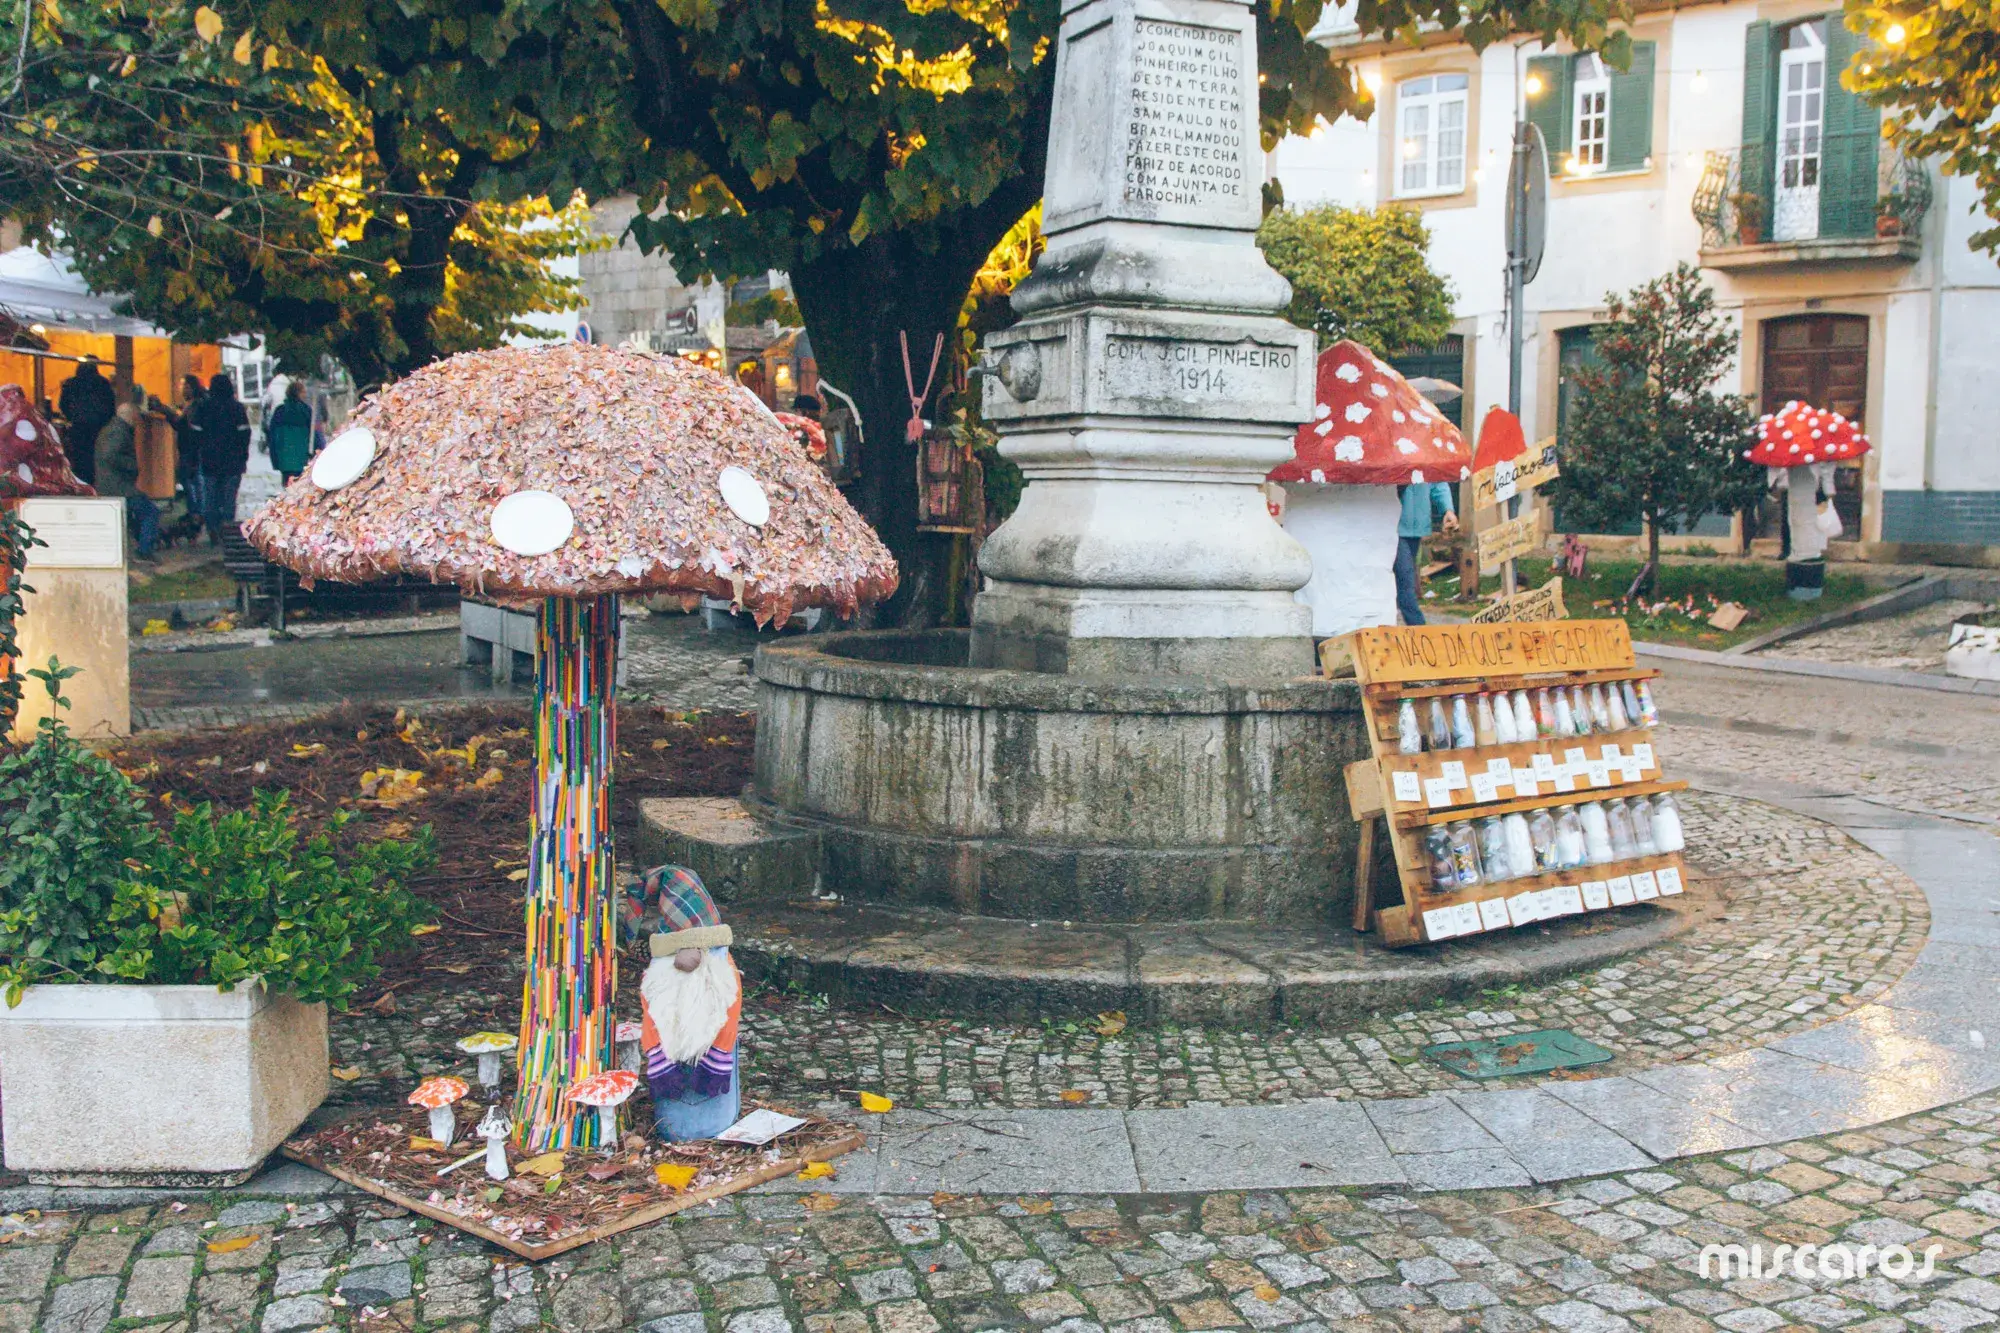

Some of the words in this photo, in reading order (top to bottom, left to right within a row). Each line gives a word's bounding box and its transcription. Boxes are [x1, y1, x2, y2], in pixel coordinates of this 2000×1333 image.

[1146, 24, 1235, 46] COMENDADOR
[1138, 41, 1203, 58] JOAQUIM
[1201, 63, 1238, 79] FILHO
[1132, 71, 1182, 89] DESTA
[1188, 79, 1238, 96] TERRA
[1132, 88, 1215, 110] RESIDENTE
[1220, 100, 1240, 112] EM
[1132, 107, 1161, 120] SAM
[1167, 111, 1213, 126] PAULO
[1220, 117, 1238, 130] NO
[1185, 130, 1240, 147] MANDOU
[1128, 139, 1172, 154] FAZER
[1175, 144, 1209, 159] ESTE
[1213, 148, 1239, 163] CHA
[1126, 154, 1164, 171] FARIZ
[1169, 161, 1184, 173] DE
[1190, 163, 1241, 179] ACORDO
[1127, 172, 1157, 186] COM
[1161, 176, 1170, 188] A
[1172, 177, 1217, 194] JUNTA
[1222, 183, 1240, 196] DE
[1207, 347, 1291, 369] PINHEIRO
[1176, 367, 1226, 394] 1914
[1395, 628, 1436, 668] NÃO
[1442, 625, 1471, 667] DÁ
